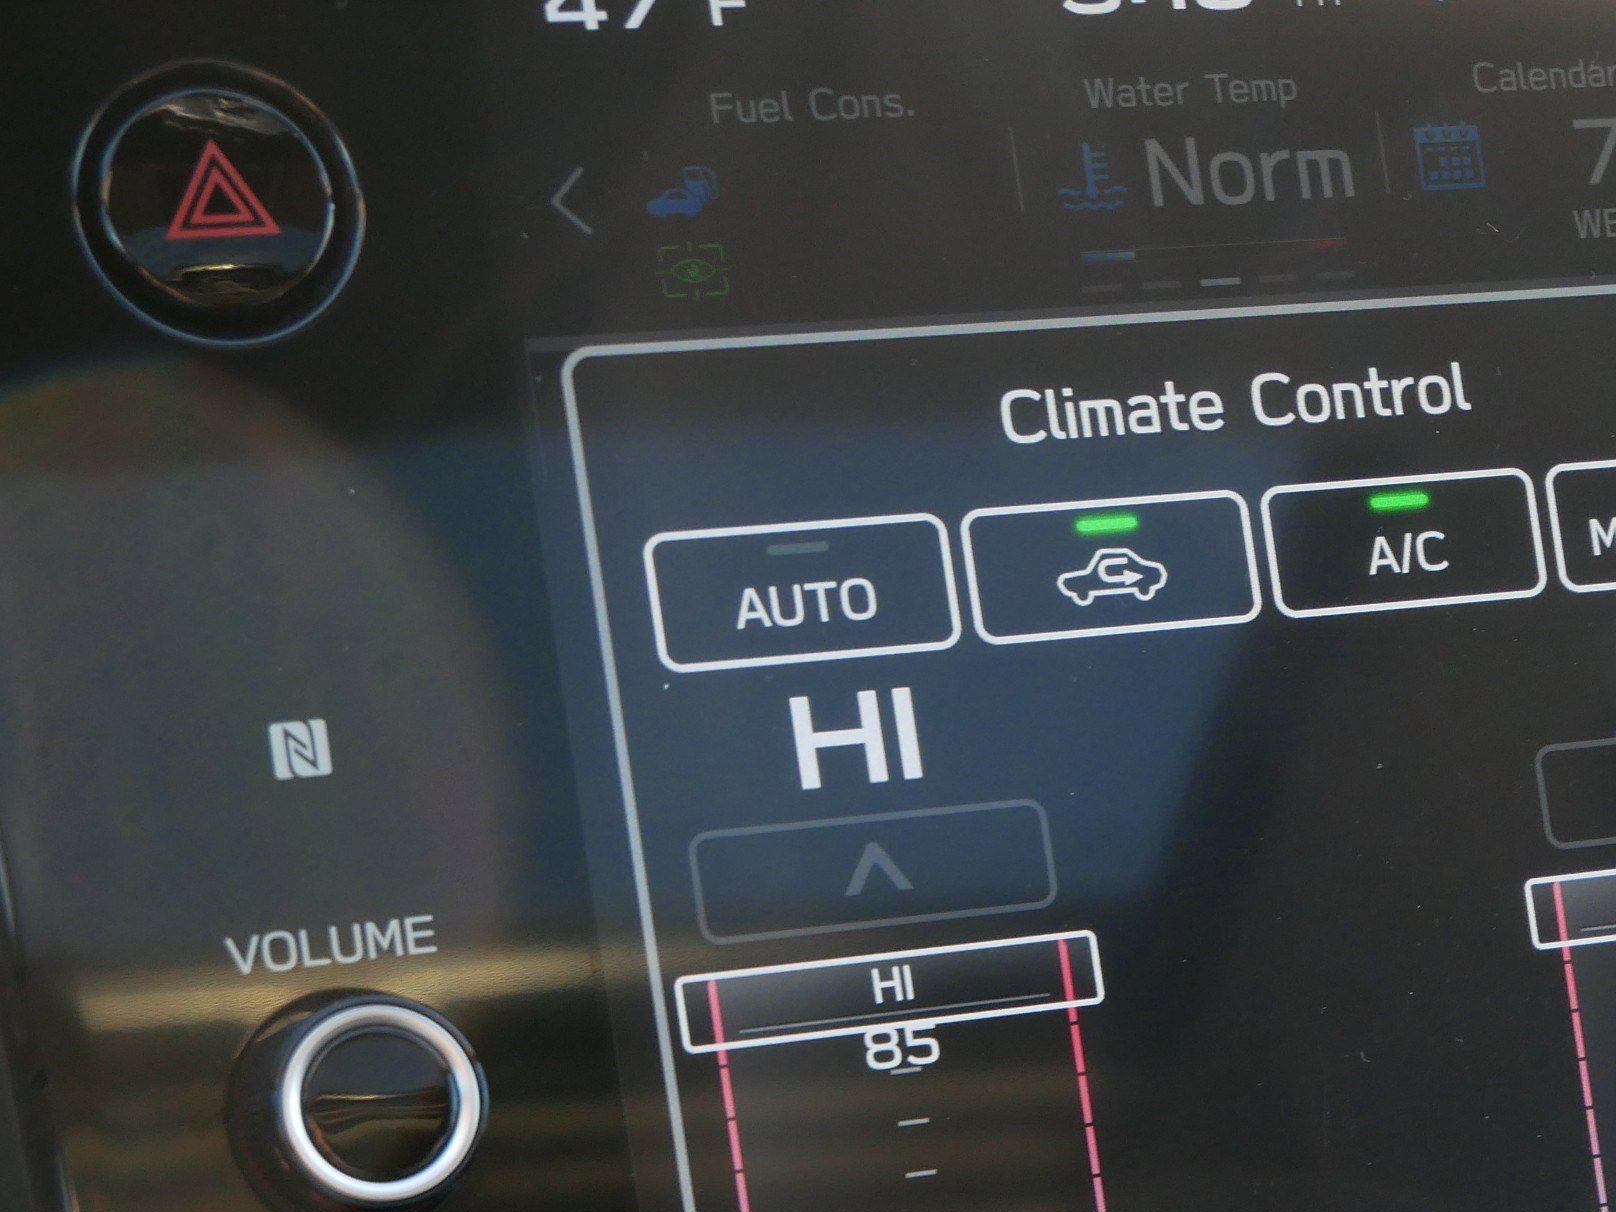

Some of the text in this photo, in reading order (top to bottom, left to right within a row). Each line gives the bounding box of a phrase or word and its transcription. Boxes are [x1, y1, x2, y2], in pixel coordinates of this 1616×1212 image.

[709, 87, 915, 124] Fuel Cons.
[1082, 72, 1297, 109] Water Temp
[1144, 136, 1355, 207] Norm
[1000, 361, 1472, 444] Climate Control
[1369, 530, 1449, 576] A/C
[736, 577, 877, 630] AUTO
[788, 686, 923, 790] HI
[224, 914, 439, 976] VOLUME
[870, 964, 915, 1004] HI
[863, 1026, 940, 1070] 85
